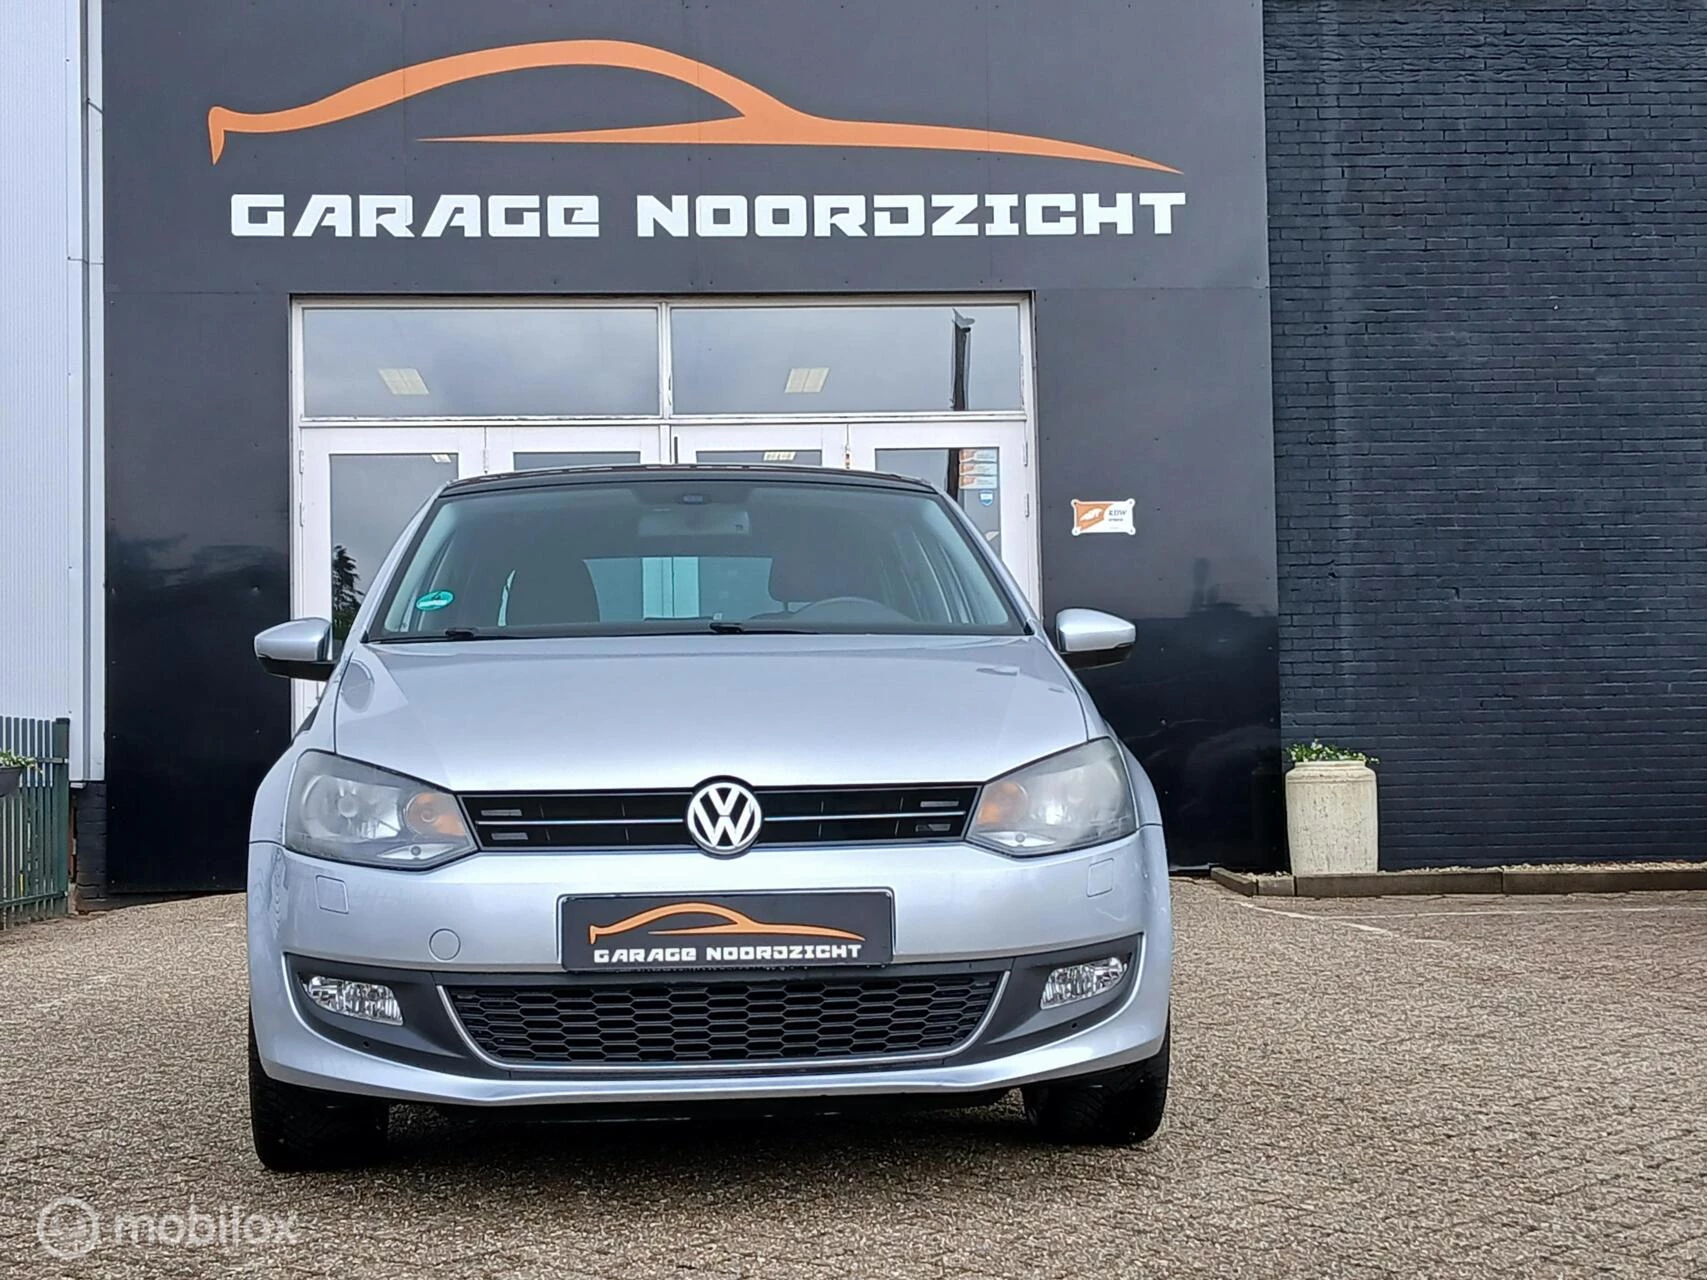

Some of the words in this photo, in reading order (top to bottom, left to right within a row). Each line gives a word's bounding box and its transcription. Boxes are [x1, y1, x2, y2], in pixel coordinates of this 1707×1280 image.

[231, 194, 599, 238] GARAGE
[636, 192, 1186, 238] NOORDZICHT
[594, 948, 696, 964] GARAGE
[706, 944, 862, 961] NOORDZICHT
